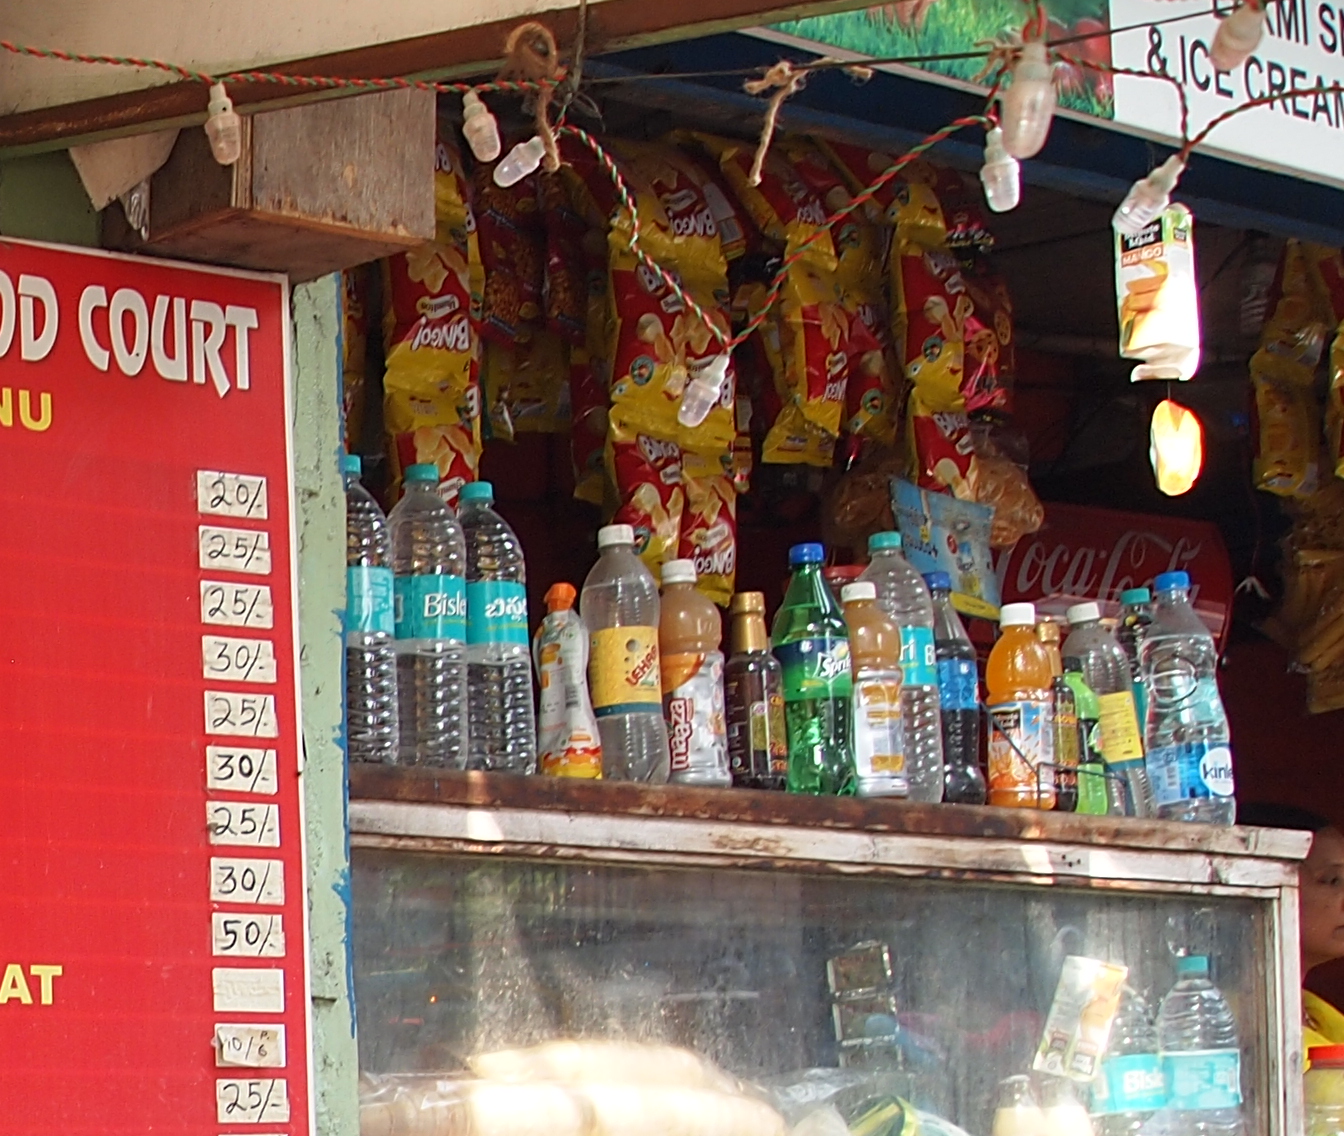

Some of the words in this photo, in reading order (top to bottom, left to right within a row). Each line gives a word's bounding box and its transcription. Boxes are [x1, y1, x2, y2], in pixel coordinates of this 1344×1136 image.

[1147, 24, 1167, 73] &
[78, 285, 259, 398] COURT
[410, 315, 470, 352] BINGO!
[423, 591, 467, 618] Bisle
[669, 697, 692, 771] maaza
